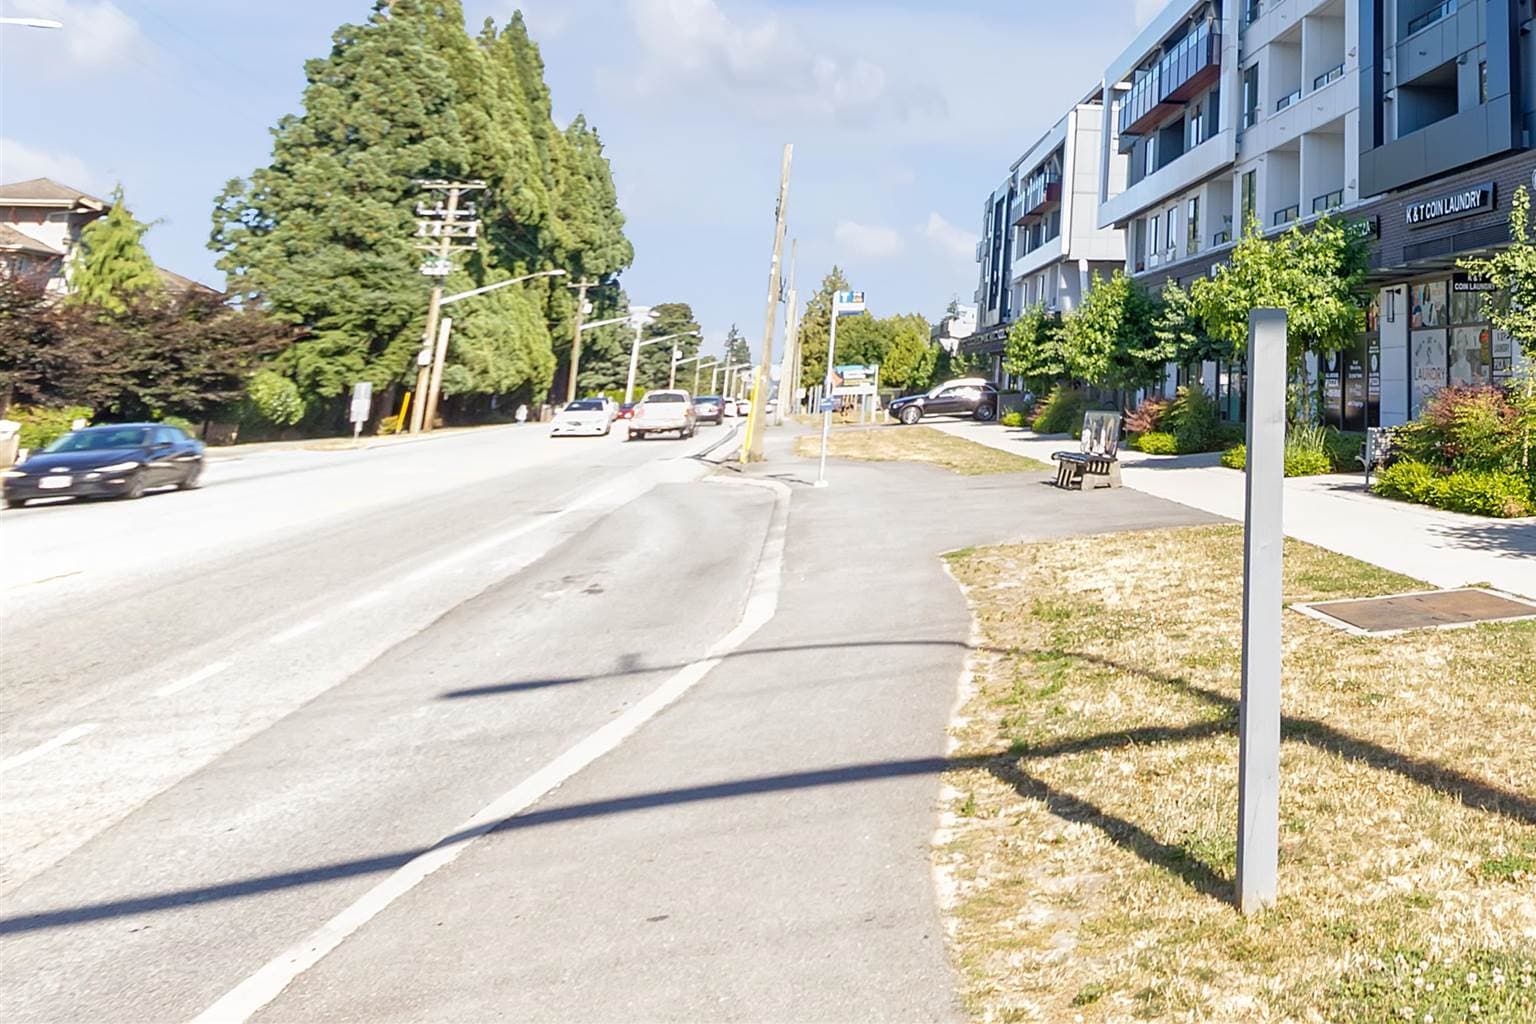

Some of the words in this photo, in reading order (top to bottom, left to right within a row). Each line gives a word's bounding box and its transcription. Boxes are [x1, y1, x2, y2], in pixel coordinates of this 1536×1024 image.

[1406, 207, 1412, 225] K
[1412, 206, 1419, 223] &
[1419, 204, 1425, 221] T
[1425, 199, 1444, 219] COIN
[1444, 189, 1481, 215] LAUNDRY
